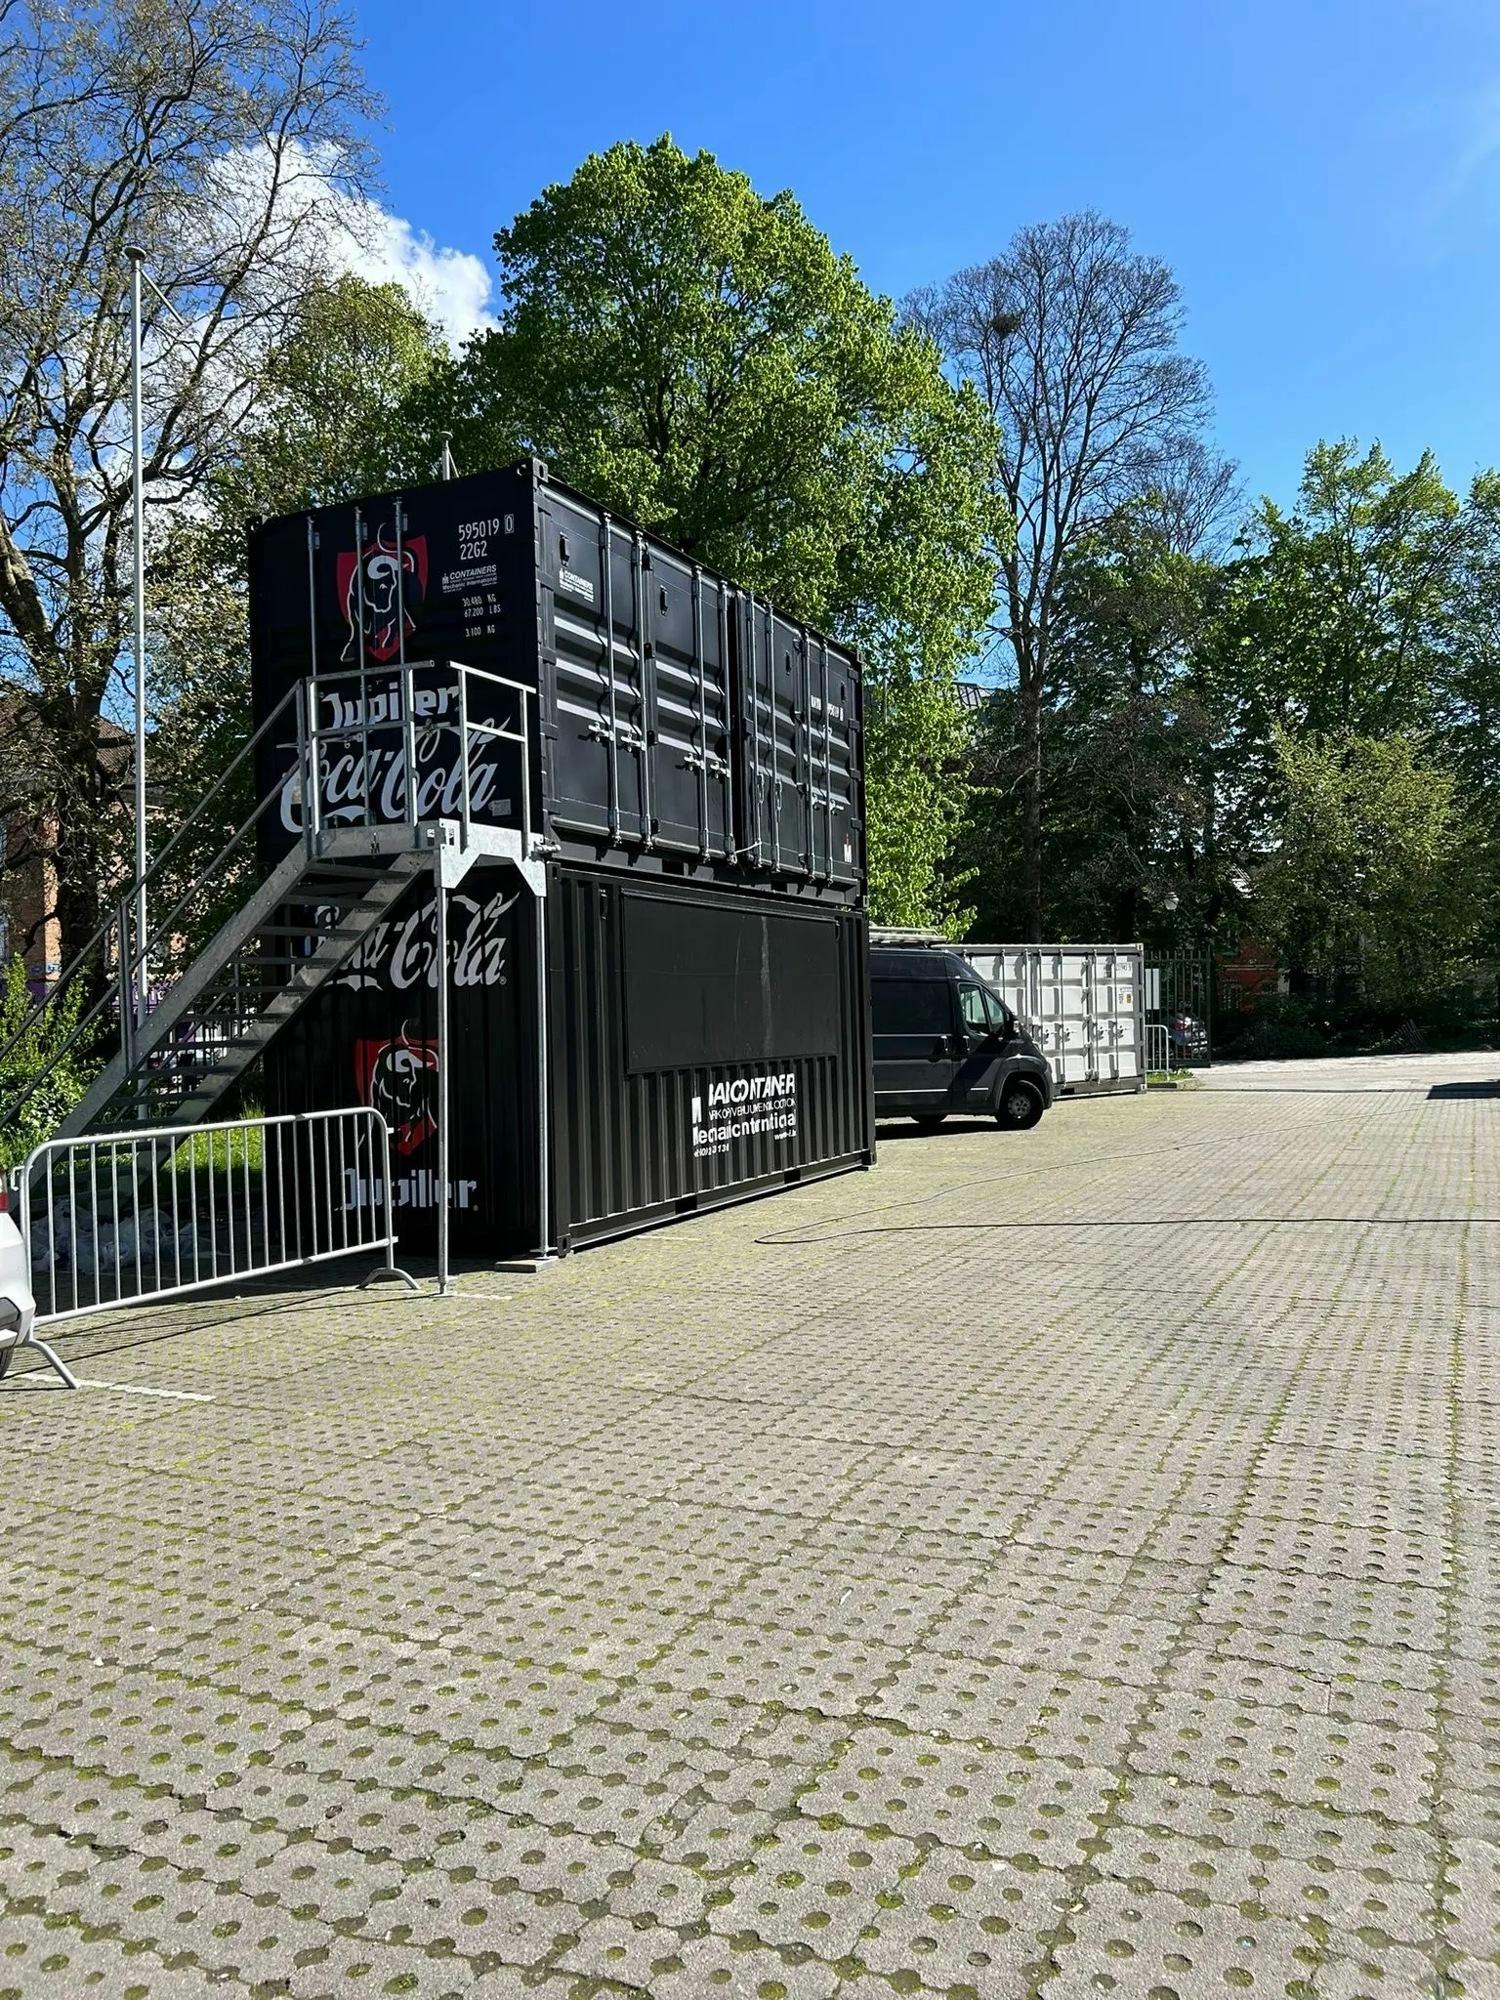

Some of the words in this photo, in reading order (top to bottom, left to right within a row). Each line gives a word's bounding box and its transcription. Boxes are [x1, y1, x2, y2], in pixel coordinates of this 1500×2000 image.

[458, 518, 500, 541] 595019
[504, 514, 514, 533] 0
[460, 540, 488, 560] 22G2
[449, 564, 497, 580] CONTAINERS
[487, 593, 497, 603] KG
[464, 607, 484, 618] 67.200
[489, 604, 501, 614] LBS
[465, 626, 482, 637] 3.100
[487, 624, 496, 634] KG
[321, 679, 460, 731] Jupier
